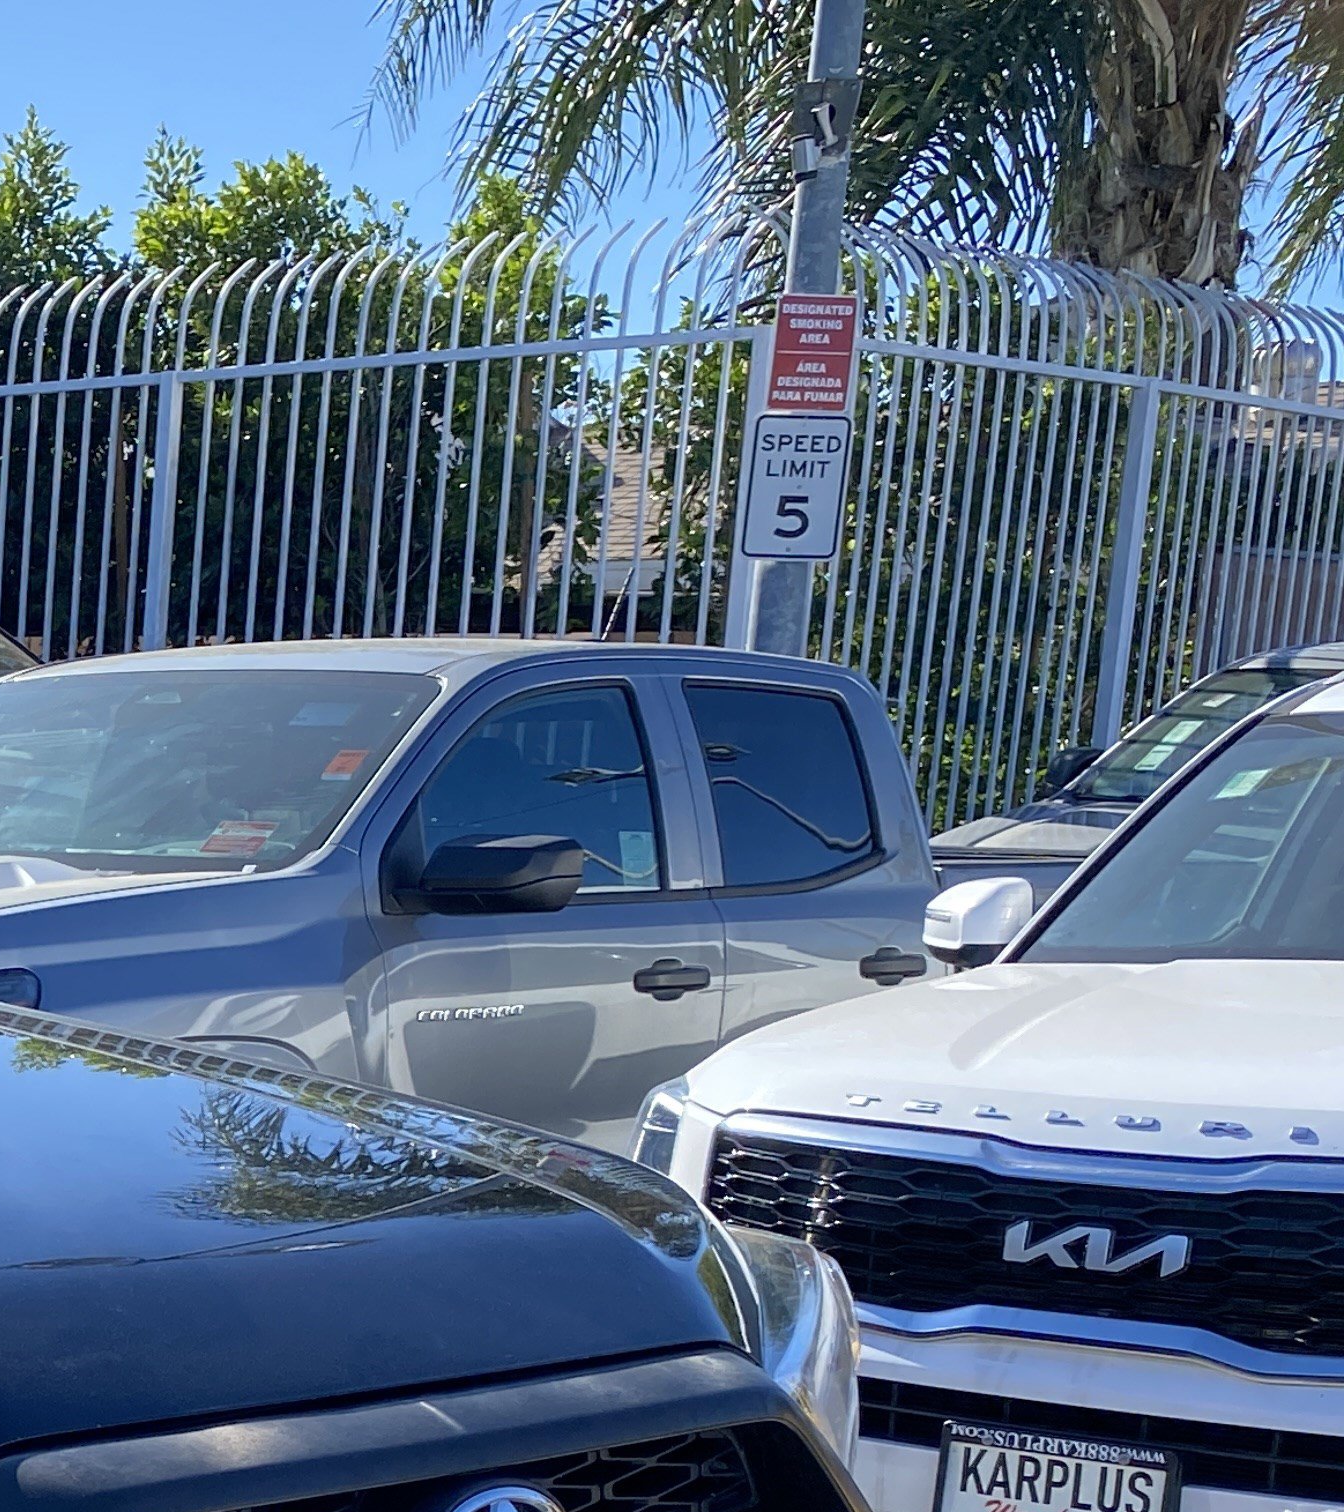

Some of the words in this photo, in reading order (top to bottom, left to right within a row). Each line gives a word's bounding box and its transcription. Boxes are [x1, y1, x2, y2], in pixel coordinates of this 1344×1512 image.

[782, 303, 853, 316] DESIGNATED
[789, 318, 843, 330] SMOKING
[799, 333, 830, 344] AREA
[777, 376, 842, 388] DESIGNADA
[772, 390, 802, 401] PARA
[803, 391, 844, 403] FUMAR
[761, 433, 842, 453] SPEED
[766, 459, 831, 478] LIMIT
[773, 495, 810, 539] 5
